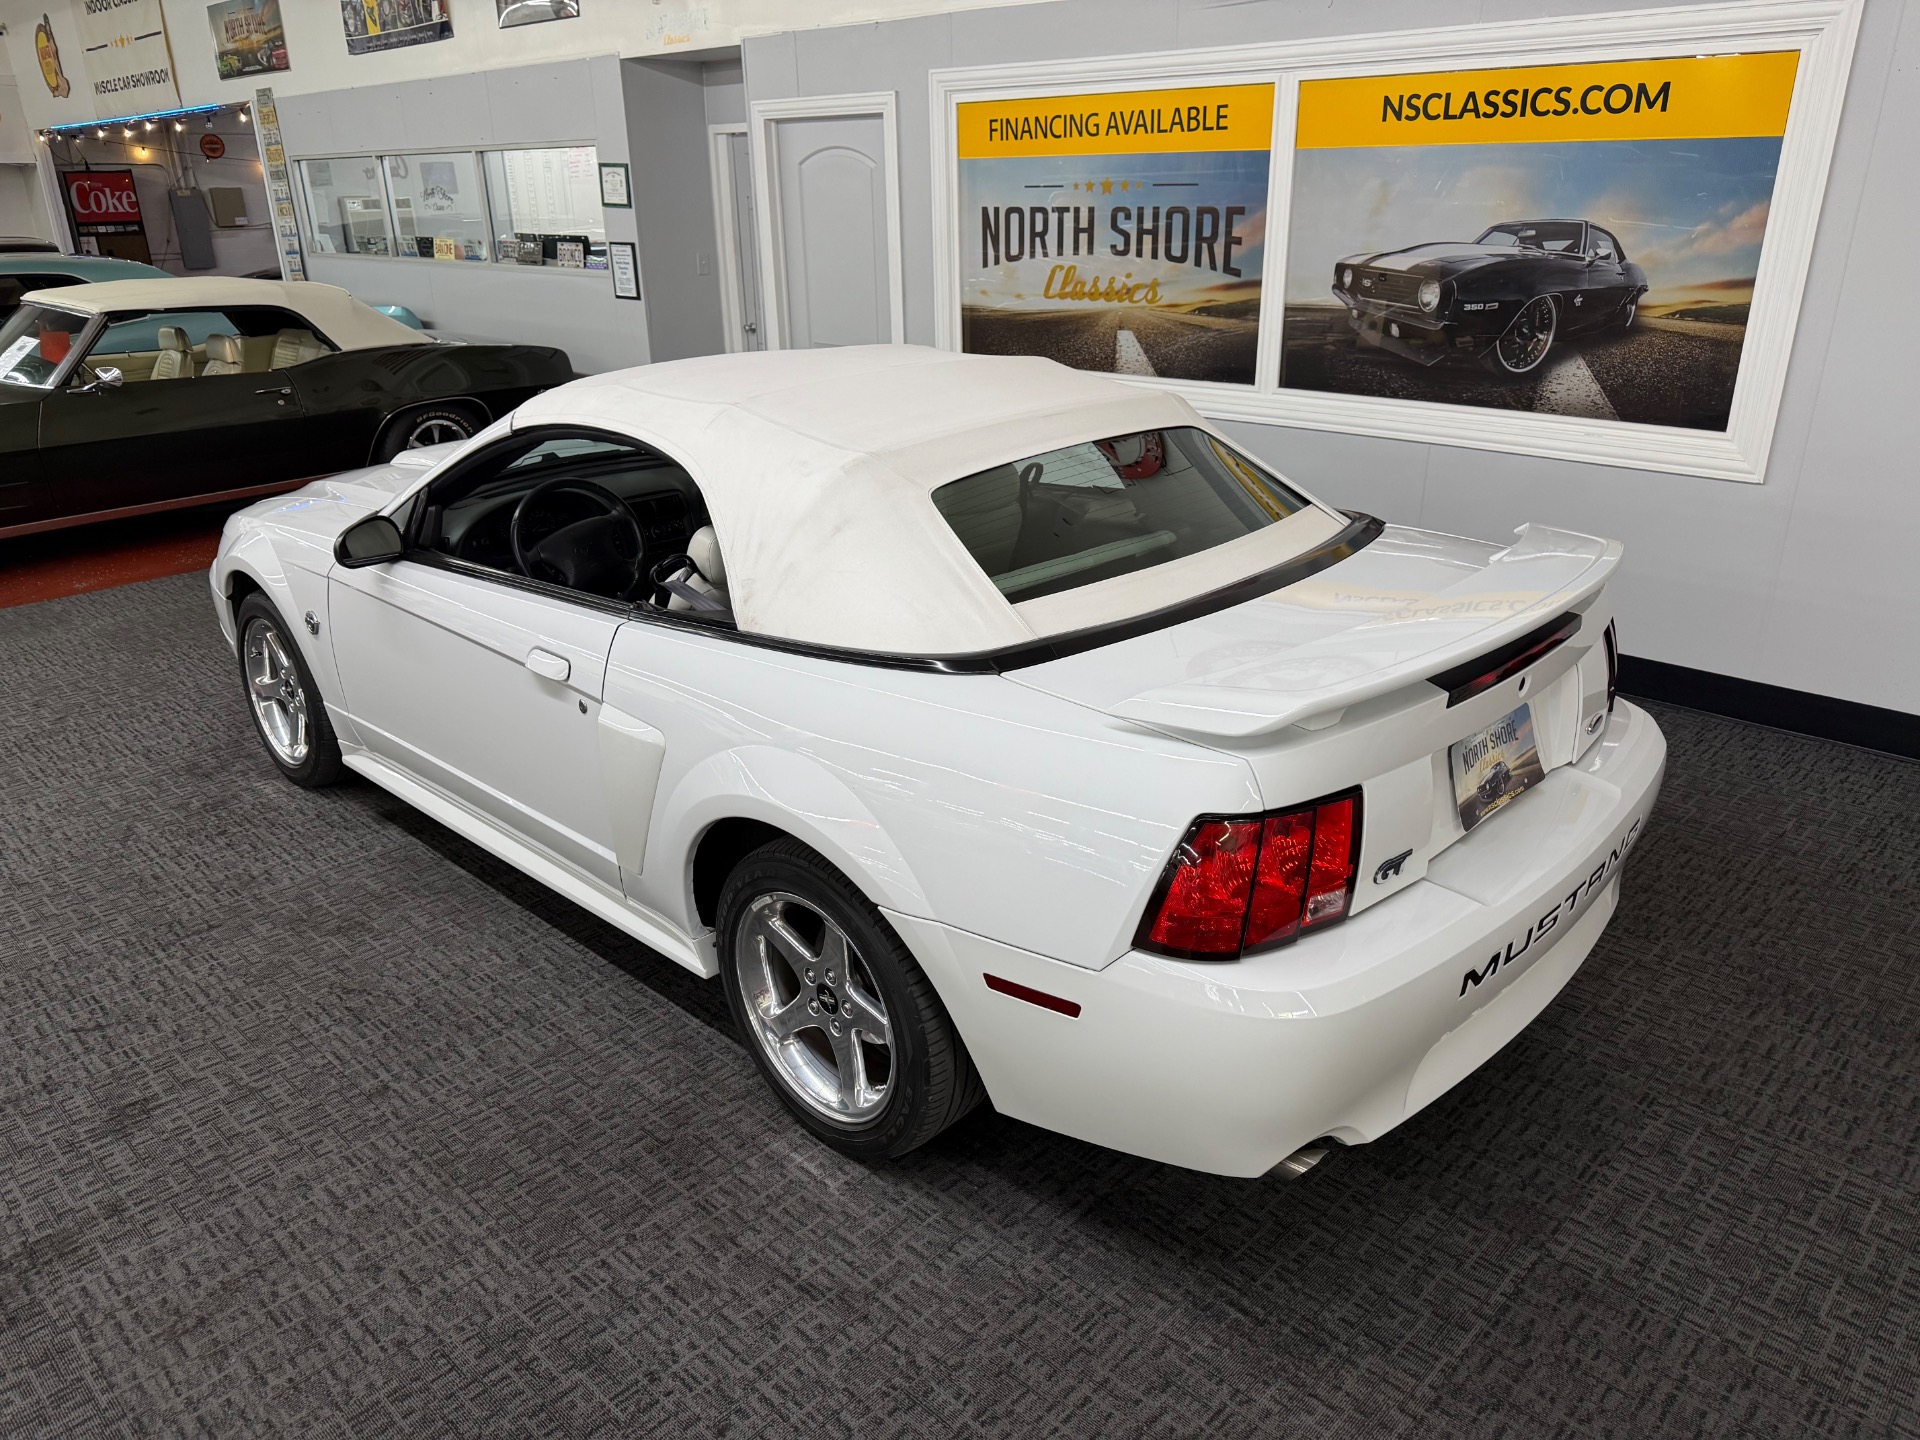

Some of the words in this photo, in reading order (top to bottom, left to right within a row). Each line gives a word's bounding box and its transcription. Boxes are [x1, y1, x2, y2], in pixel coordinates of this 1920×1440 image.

[94, 78, 119, 96] MUSCLE
[118, 75, 130, 91] CAR
[130, 67, 170, 88] SHOWROOM
[1381, 81, 1672, 123] NSCLASSICS.COM
[988, 112, 1100, 142] FINANCING
[1105, 104, 1229, 137] AVAILABLE
[70, 181, 139, 214] Coke
[981, 206, 1096, 269] NORTH
[1109, 206, 1246, 278] SHORE
[1043, 264, 1164, 305] Classics
[1463, 303, 1484, 311] 350
[1462, 737, 1489, 775] NORTH
[1490, 719, 1519, 750] SHORE
[1373, 848, 1414, 884] GT
[1458, 816, 1641, 998] MUSTANG
